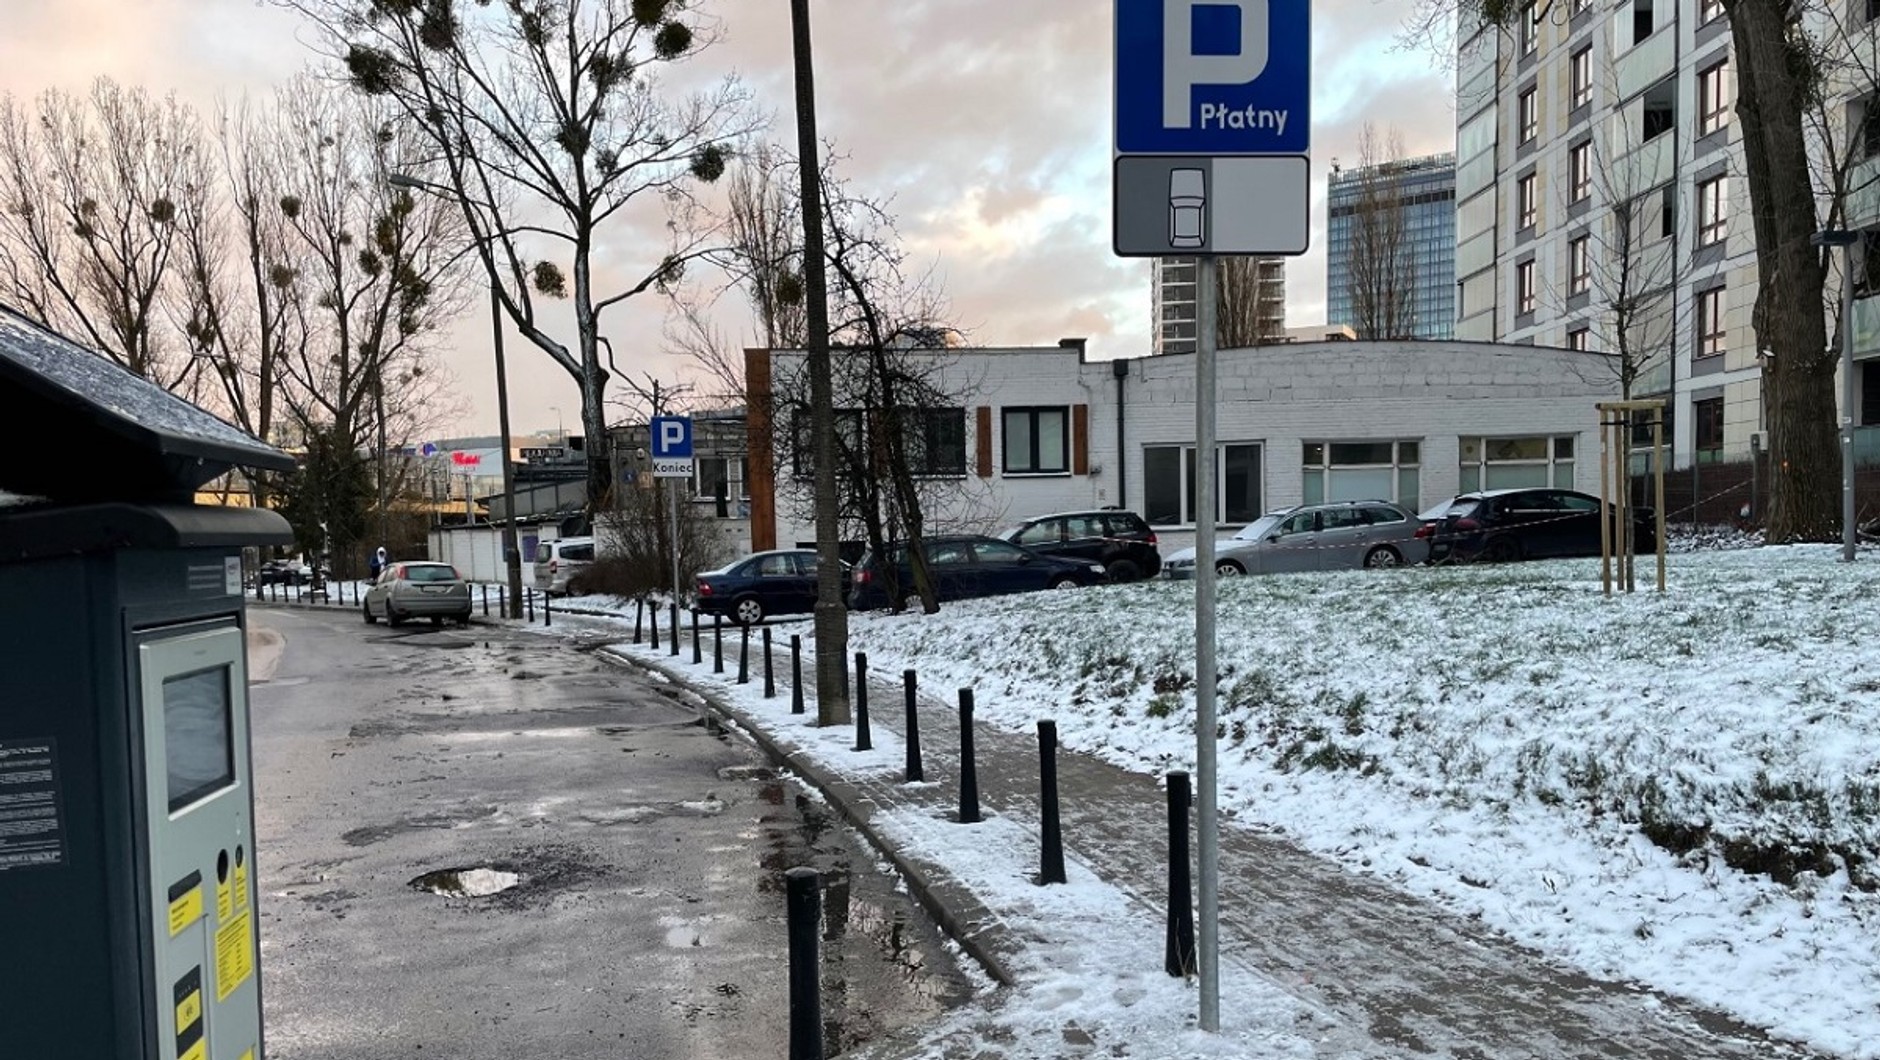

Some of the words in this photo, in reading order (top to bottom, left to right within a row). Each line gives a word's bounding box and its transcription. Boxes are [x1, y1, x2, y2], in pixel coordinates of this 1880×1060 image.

[1163, 0, 1269, 128] P
[1201, 103, 1288, 136] Płatny
[661, 421, 684, 452] P
[653, 462, 693, 472] Koniec
